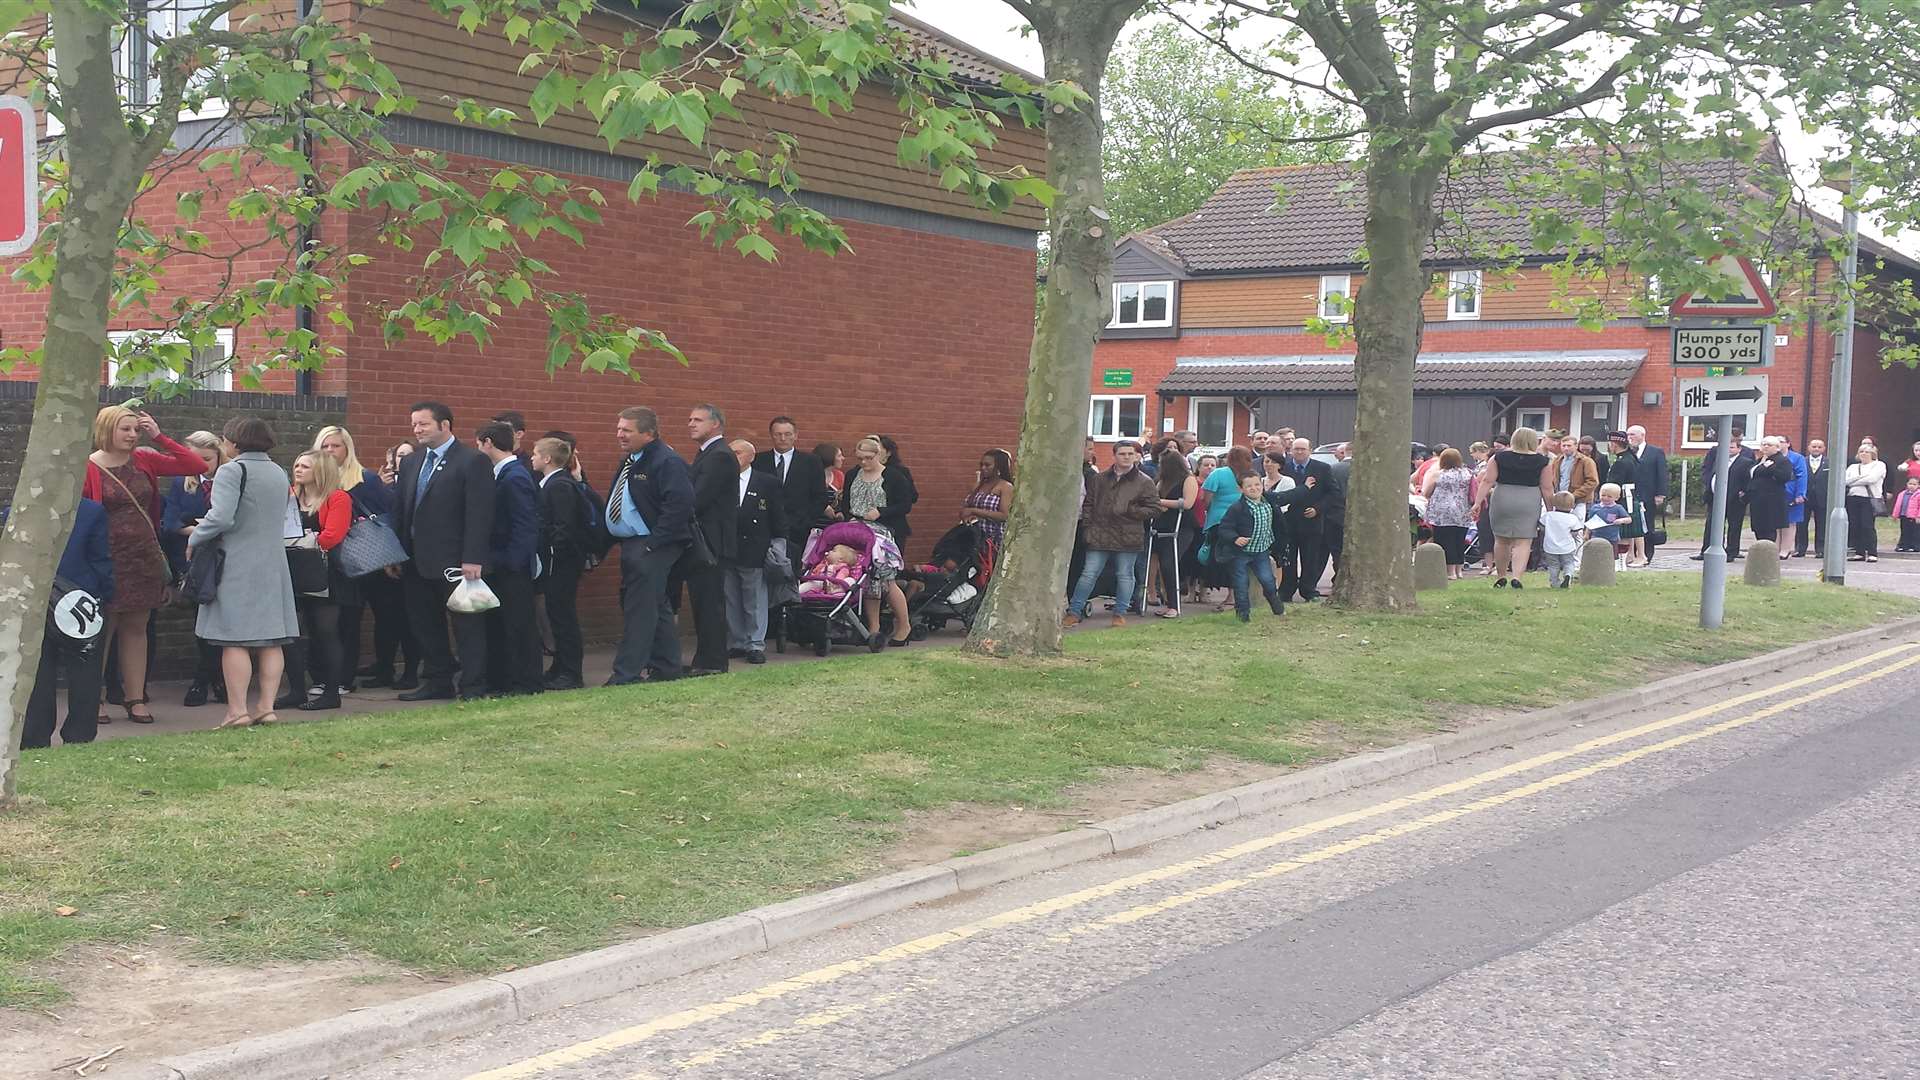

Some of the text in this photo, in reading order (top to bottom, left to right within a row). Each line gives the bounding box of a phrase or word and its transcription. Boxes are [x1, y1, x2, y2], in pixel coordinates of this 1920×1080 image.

[1679, 332, 1759, 346] Humps for
[1681, 346, 1756, 359] 300 yds
[1684, 384, 1710, 408] DHE
